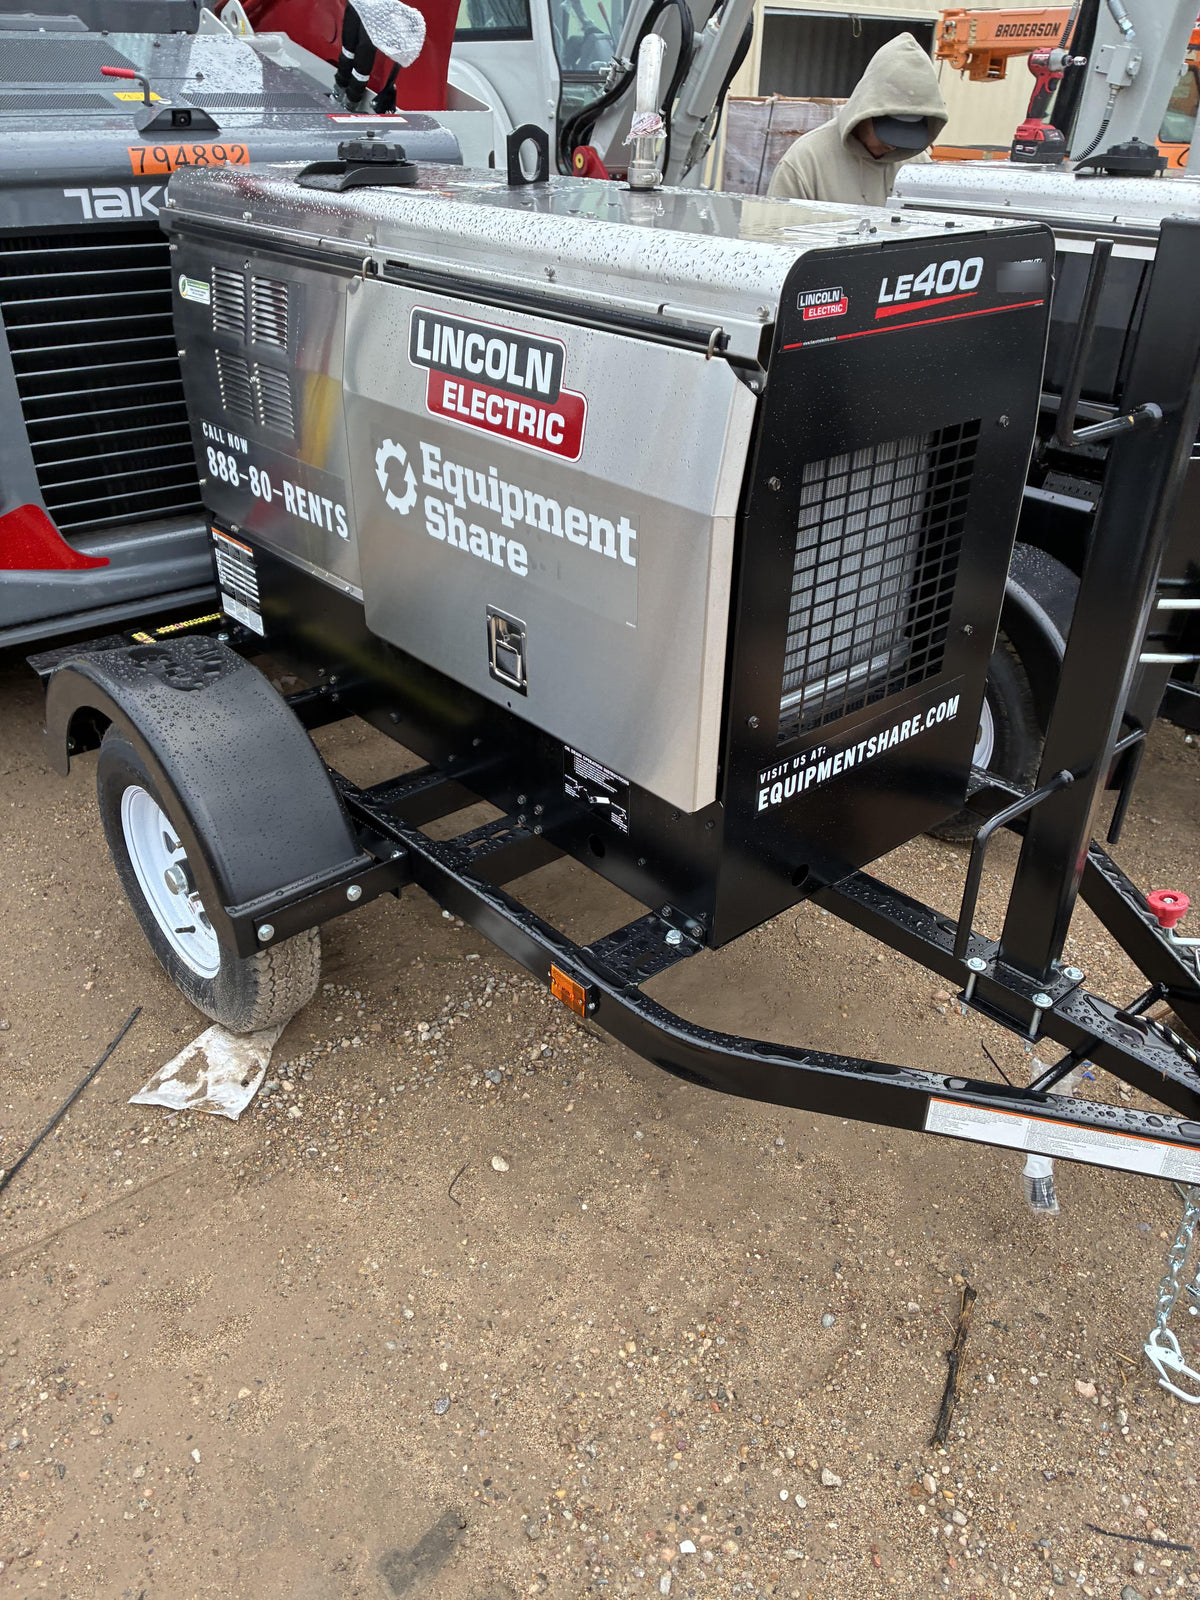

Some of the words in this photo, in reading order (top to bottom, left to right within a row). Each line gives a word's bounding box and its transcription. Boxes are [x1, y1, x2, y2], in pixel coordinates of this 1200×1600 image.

[995, 22, 1061, 37] BRODERSON
[131, 144, 245, 173] 794892
[800, 290, 840, 307] LINCOLN
[877, 256, 984, 304] LE400
[808, 303, 843, 317] ELECTRIC
[415, 319, 554, 394] LINCOLN
[442, 381, 565, 445] ELECTRIC
[202, 422, 226, 444] CALL
[227, 433, 248, 453] NOW
[205, 445, 349, 539] 888-80-RENTS
[419, 441, 637, 567] Equipment
[424, 495, 528, 577] Share
[757, 695, 960, 812] EQUIPMENTSHARE.COM
[759, 763, 789, 784] VISIT
[793, 754, 806, 769] US
[810, 746, 827, 761] AT:
